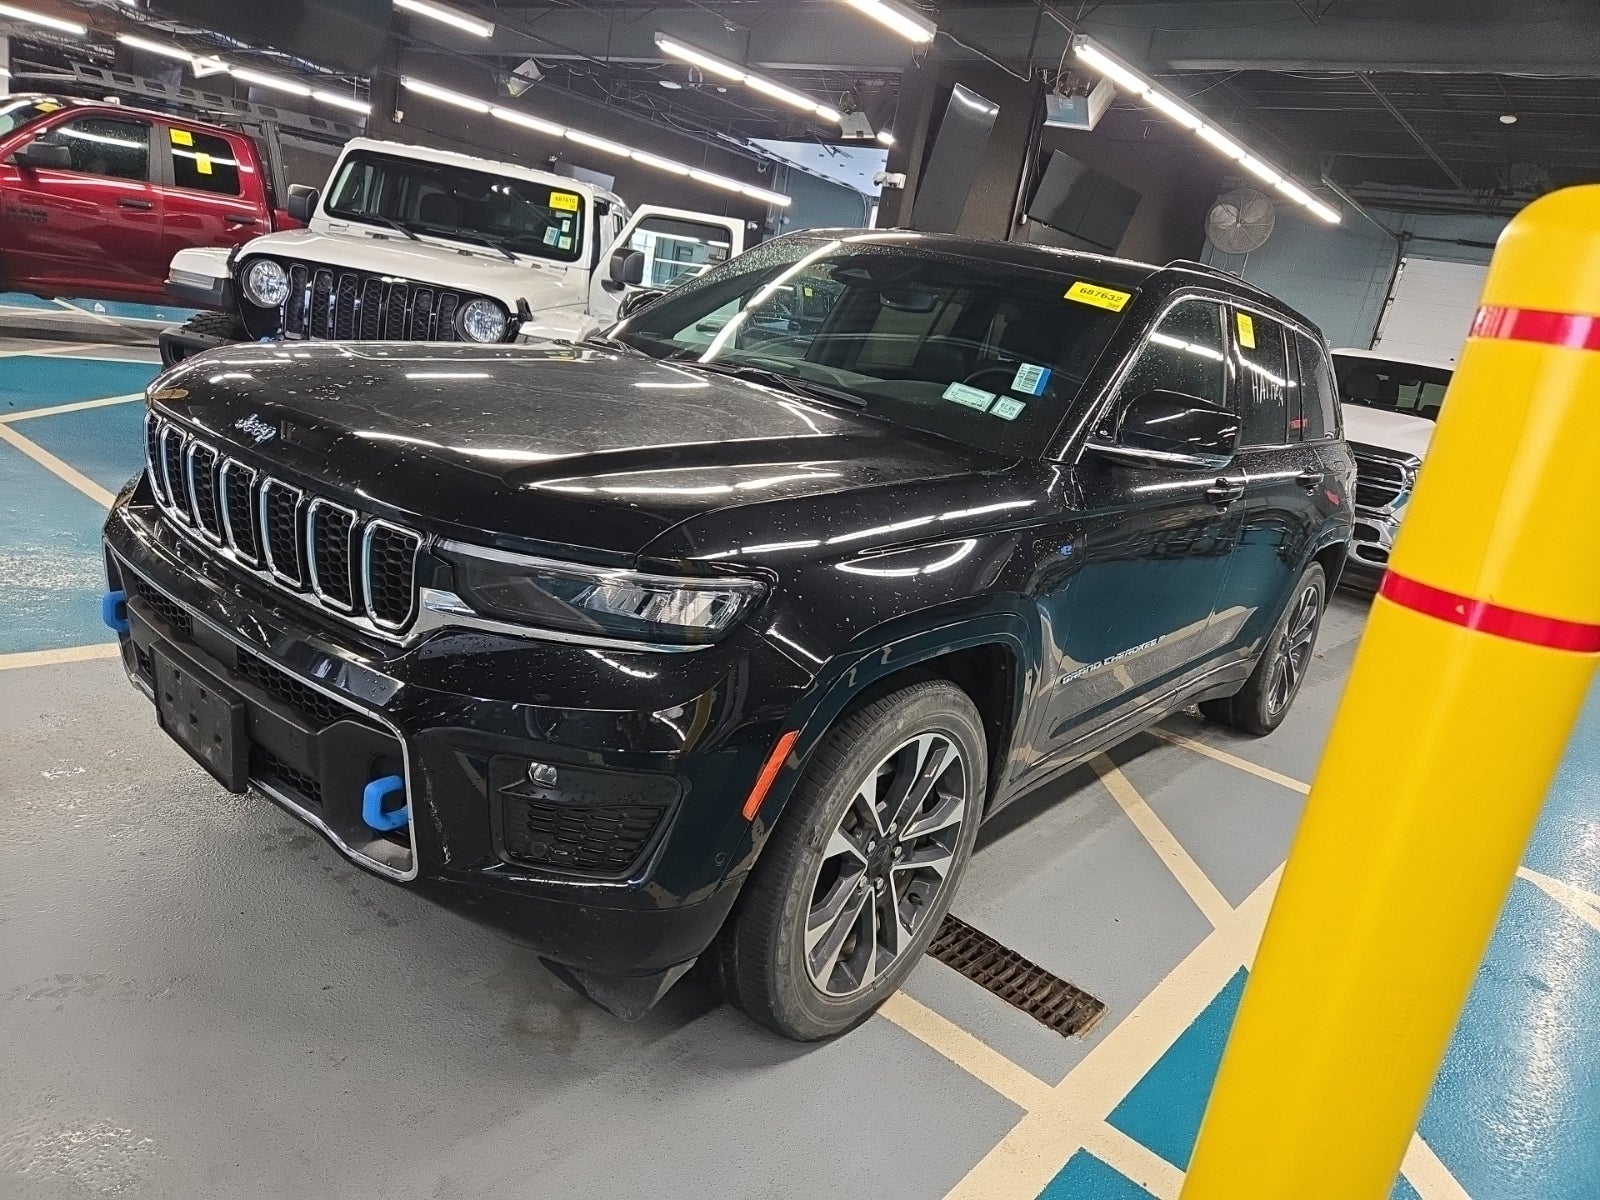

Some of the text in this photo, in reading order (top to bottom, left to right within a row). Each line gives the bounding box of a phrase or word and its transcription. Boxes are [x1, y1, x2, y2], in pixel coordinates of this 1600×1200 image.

[1080, 287, 1123, 302] 687632
[234, 413, 277, 443] Jeep
[1062, 637, 1158, 685] GRAND CHEROKEE
